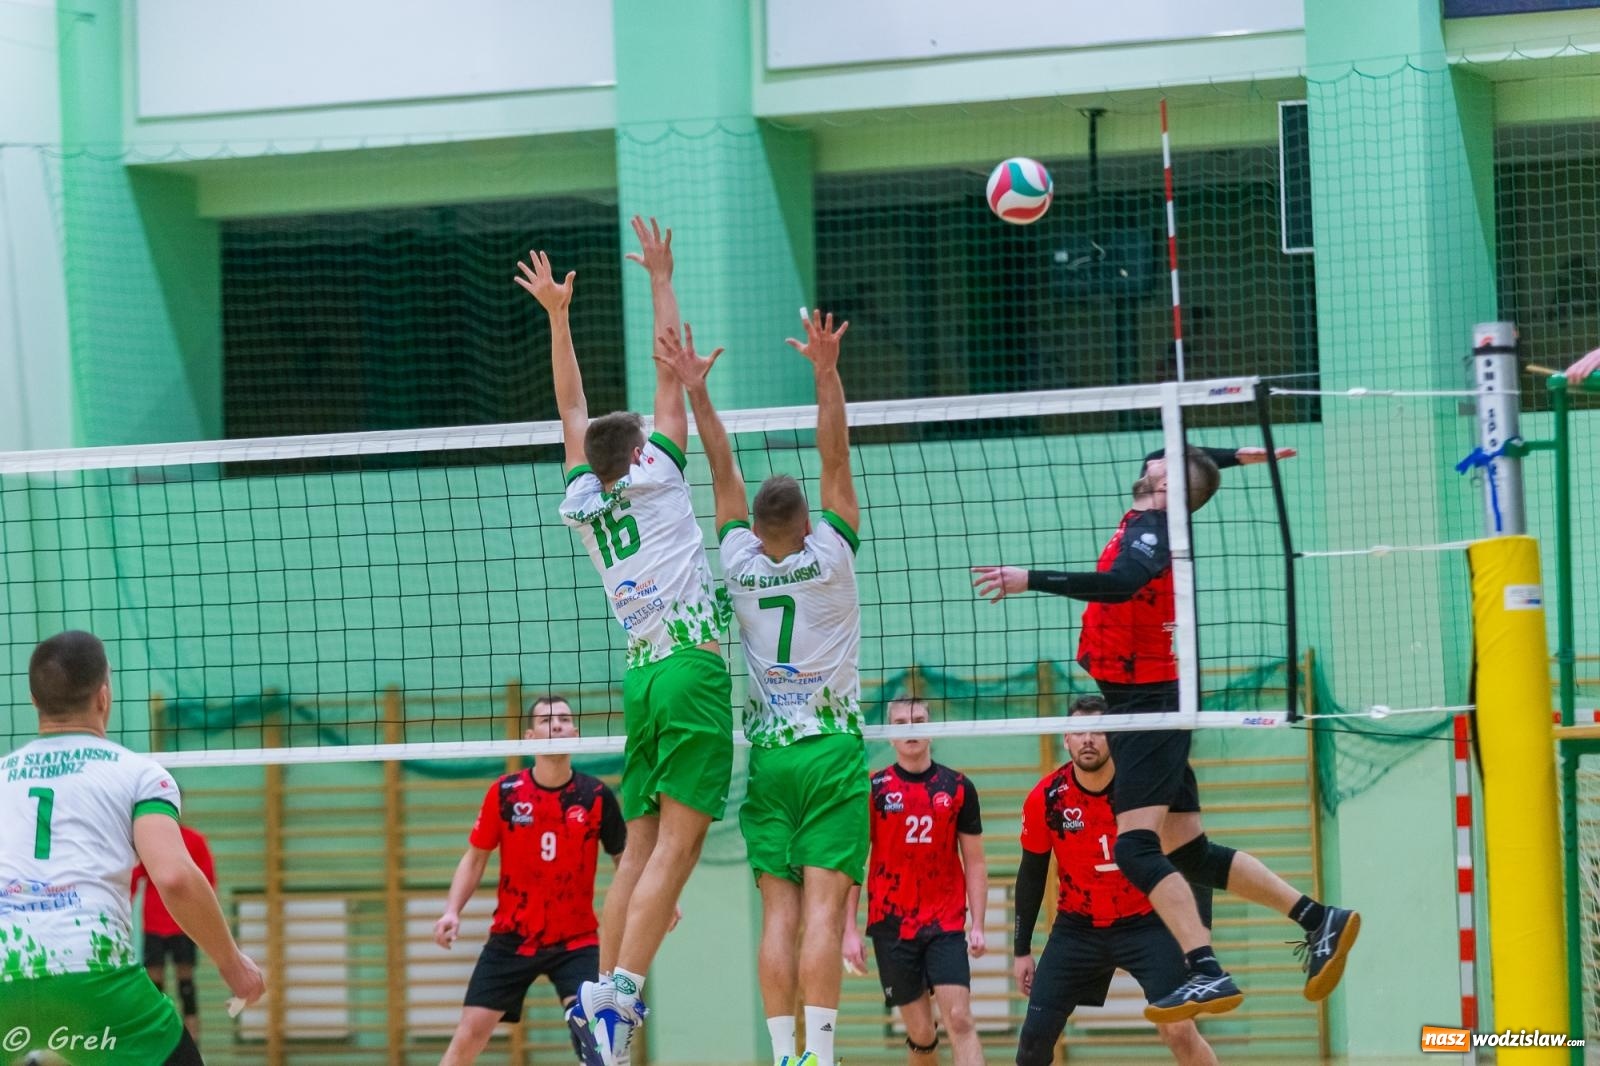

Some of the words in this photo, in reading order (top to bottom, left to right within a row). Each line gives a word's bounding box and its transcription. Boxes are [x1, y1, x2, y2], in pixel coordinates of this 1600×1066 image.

[590, 500, 641, 569] 16
[758, 595, 796, 664] 7
[28, 787, 54, 860] 1
[541, 831, 557, 861] 9
[905, 815, 933, 843] 22
[1062, 820, 1085, 830] radlin
